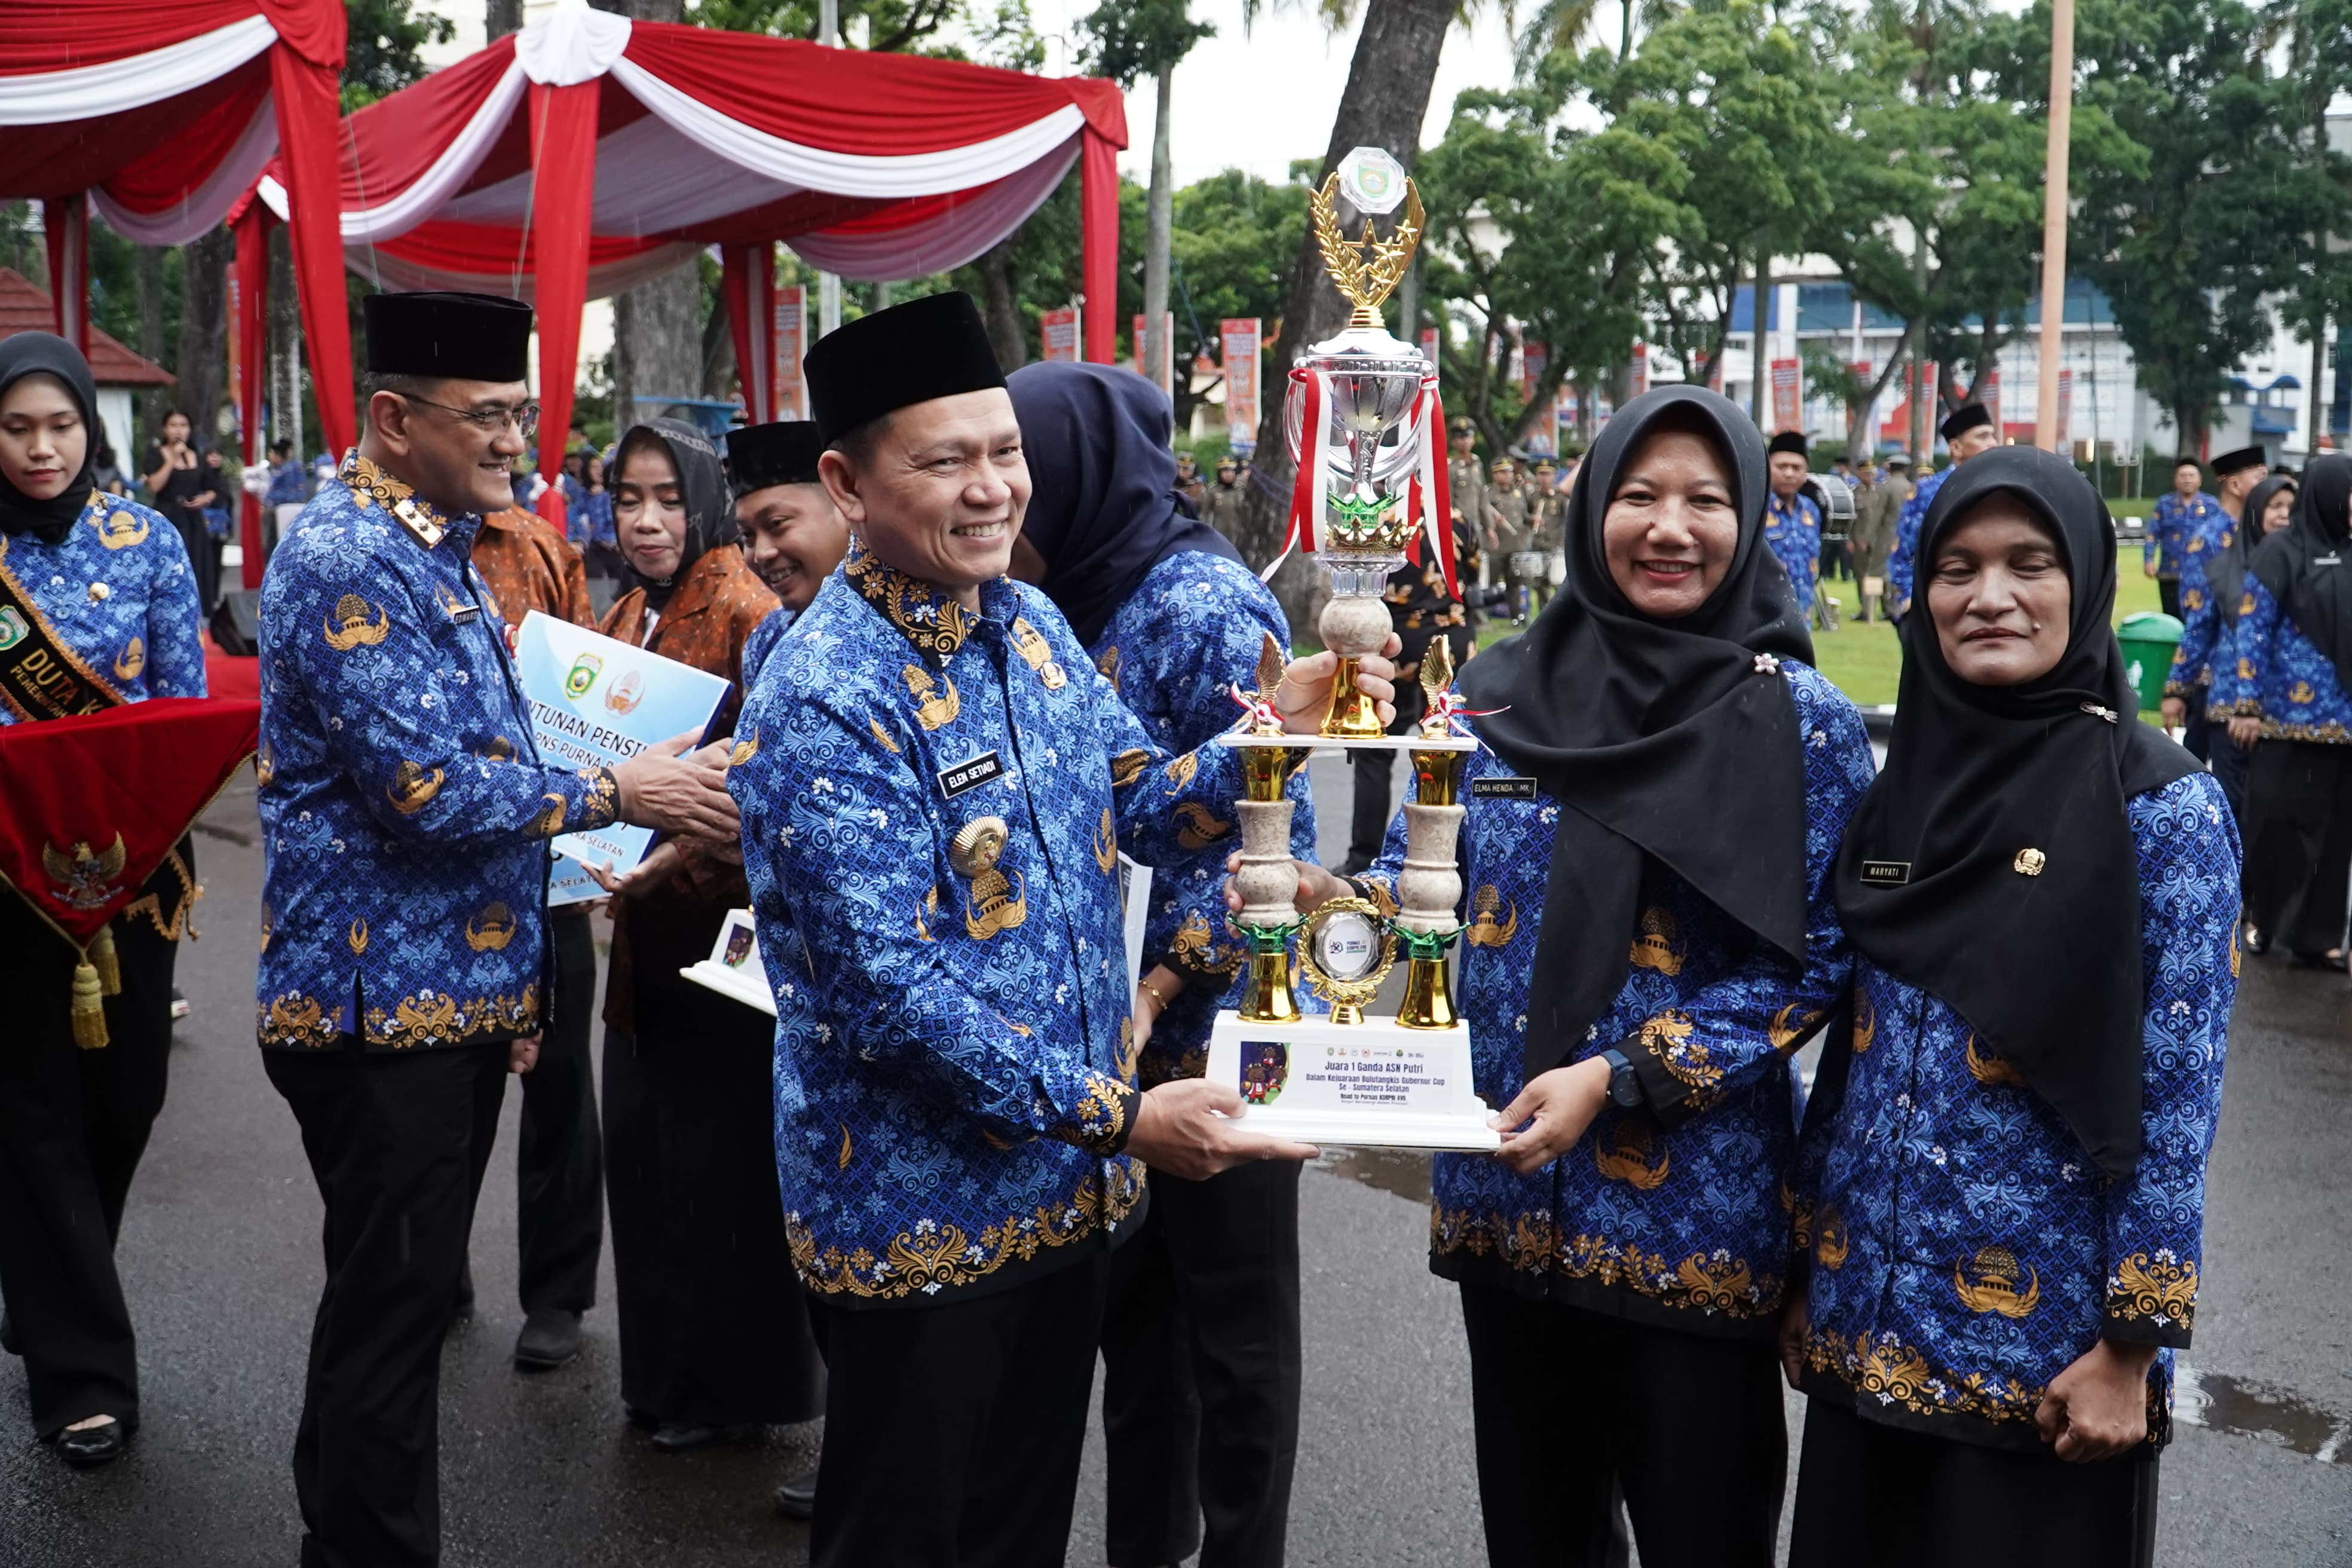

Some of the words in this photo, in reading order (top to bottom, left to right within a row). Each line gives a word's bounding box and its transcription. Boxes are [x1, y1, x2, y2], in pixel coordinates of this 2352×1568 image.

[22, 648, 79, 705] DUTA
[590, 727, 647, 758] PENSI
[948, 771, 969, 789] ELEN
[968, 760, 996, 779] SETIADI
[1474, 783, 1492, 792] ELMA
[588, 835, 624, 857] SELATAN
[1870, 866, 1899, 877] MARYATI
[560, 875, 596, 887] SELAT
[1325, 1061, 1349, 1070] Juara
[1352, 1062, 1355, 1071] 1
[1358, 1062, 1383, 1071] Ganda
[1386, 1063, 1401, 1073] ASN
[1404, 1064, 1423, 1073] Putri
[1362, 1075, 1399, 1084] Bulutangkis
